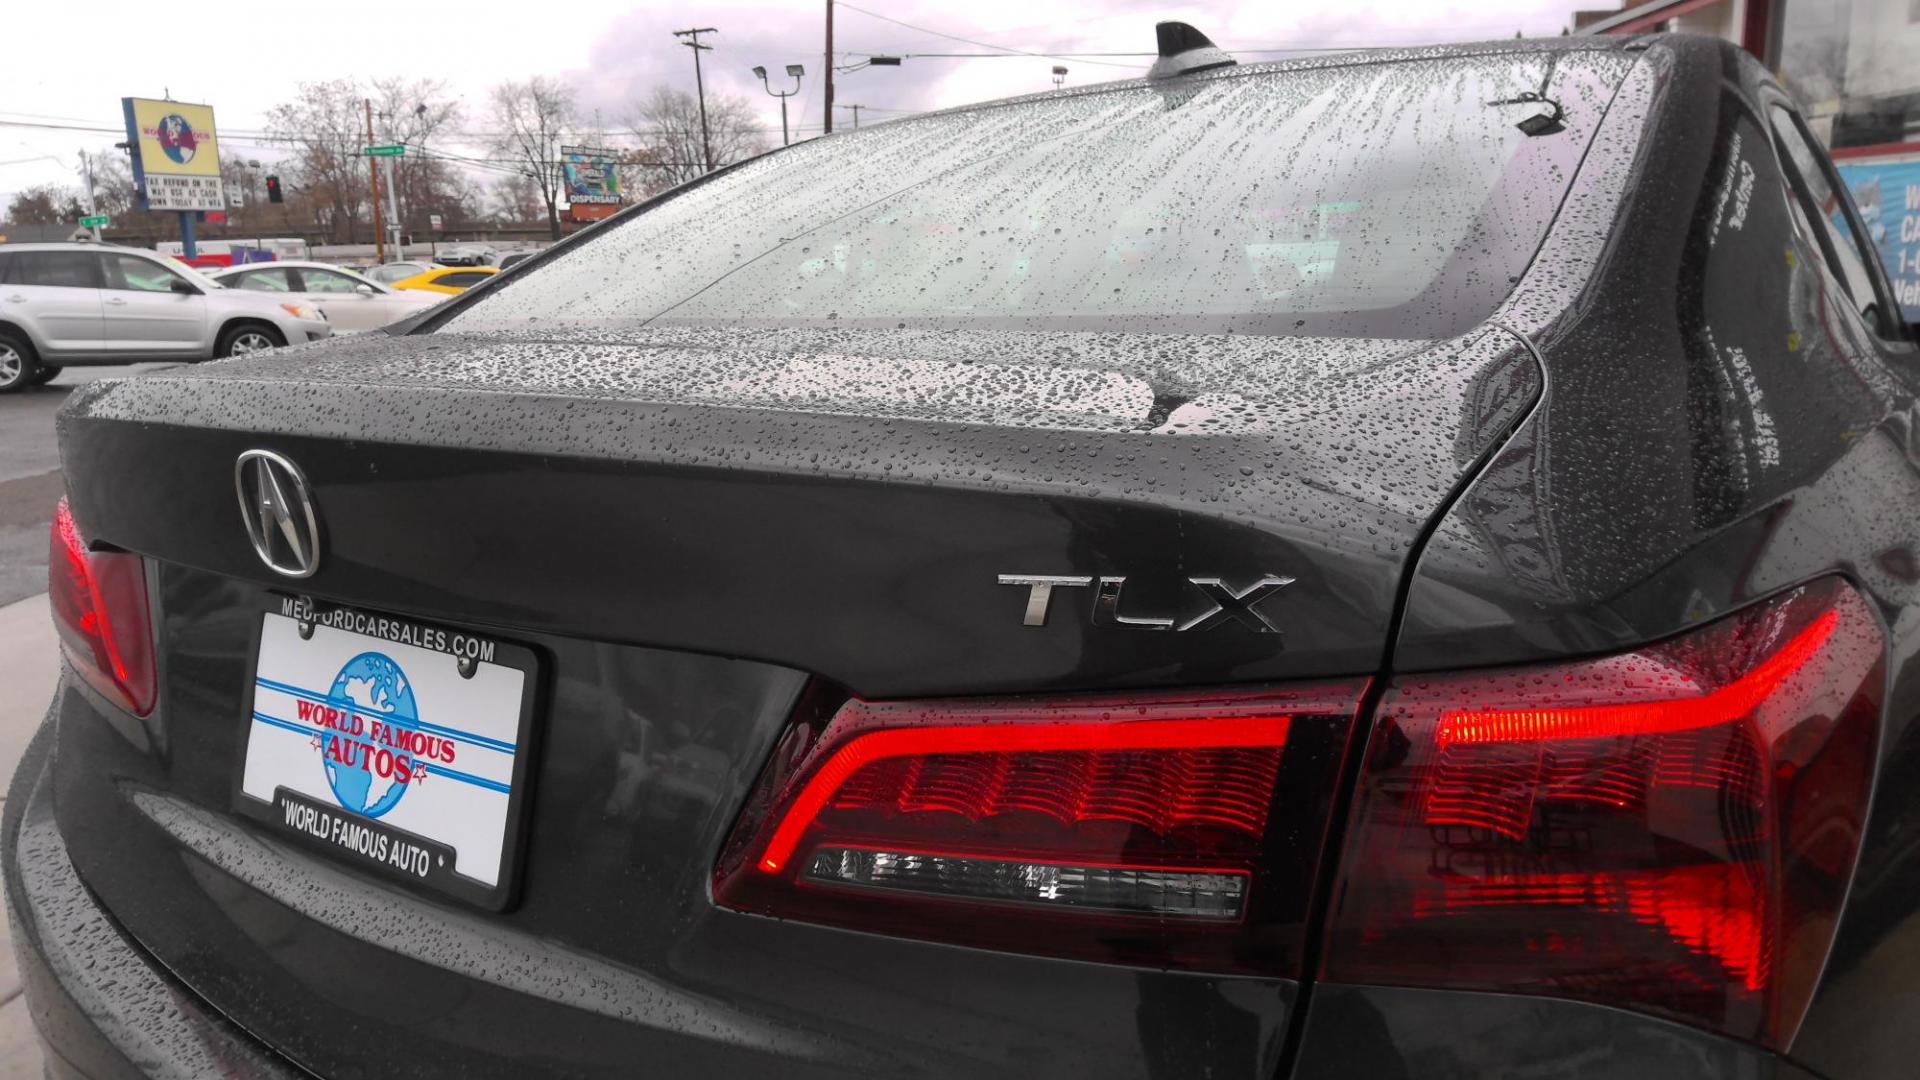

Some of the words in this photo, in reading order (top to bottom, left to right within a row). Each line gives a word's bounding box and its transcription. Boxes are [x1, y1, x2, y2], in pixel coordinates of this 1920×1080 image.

[151, 188, 165, 196] WAY
[188, 189, 197, 197] AS
[200, 189, 217, 198] CASH
[163, 178, 189, 187] REFUND
[192, 179, 201, 187] ON
[171, 198, 192, 206] TODAY
[570, 194, 619, 203] DISPENSARY
[997, 573, 1296, 633] TLX
[296, 699, 364, 736] WORLD
[370, 720, 456, 764] FAMOUS
[324, 735, 413, 784] AUTOS
[285, 800, 330, 839] WORLD
[331, 817, 388, 862] FAMOUS
[388, 840, 430, 877] AUTO
